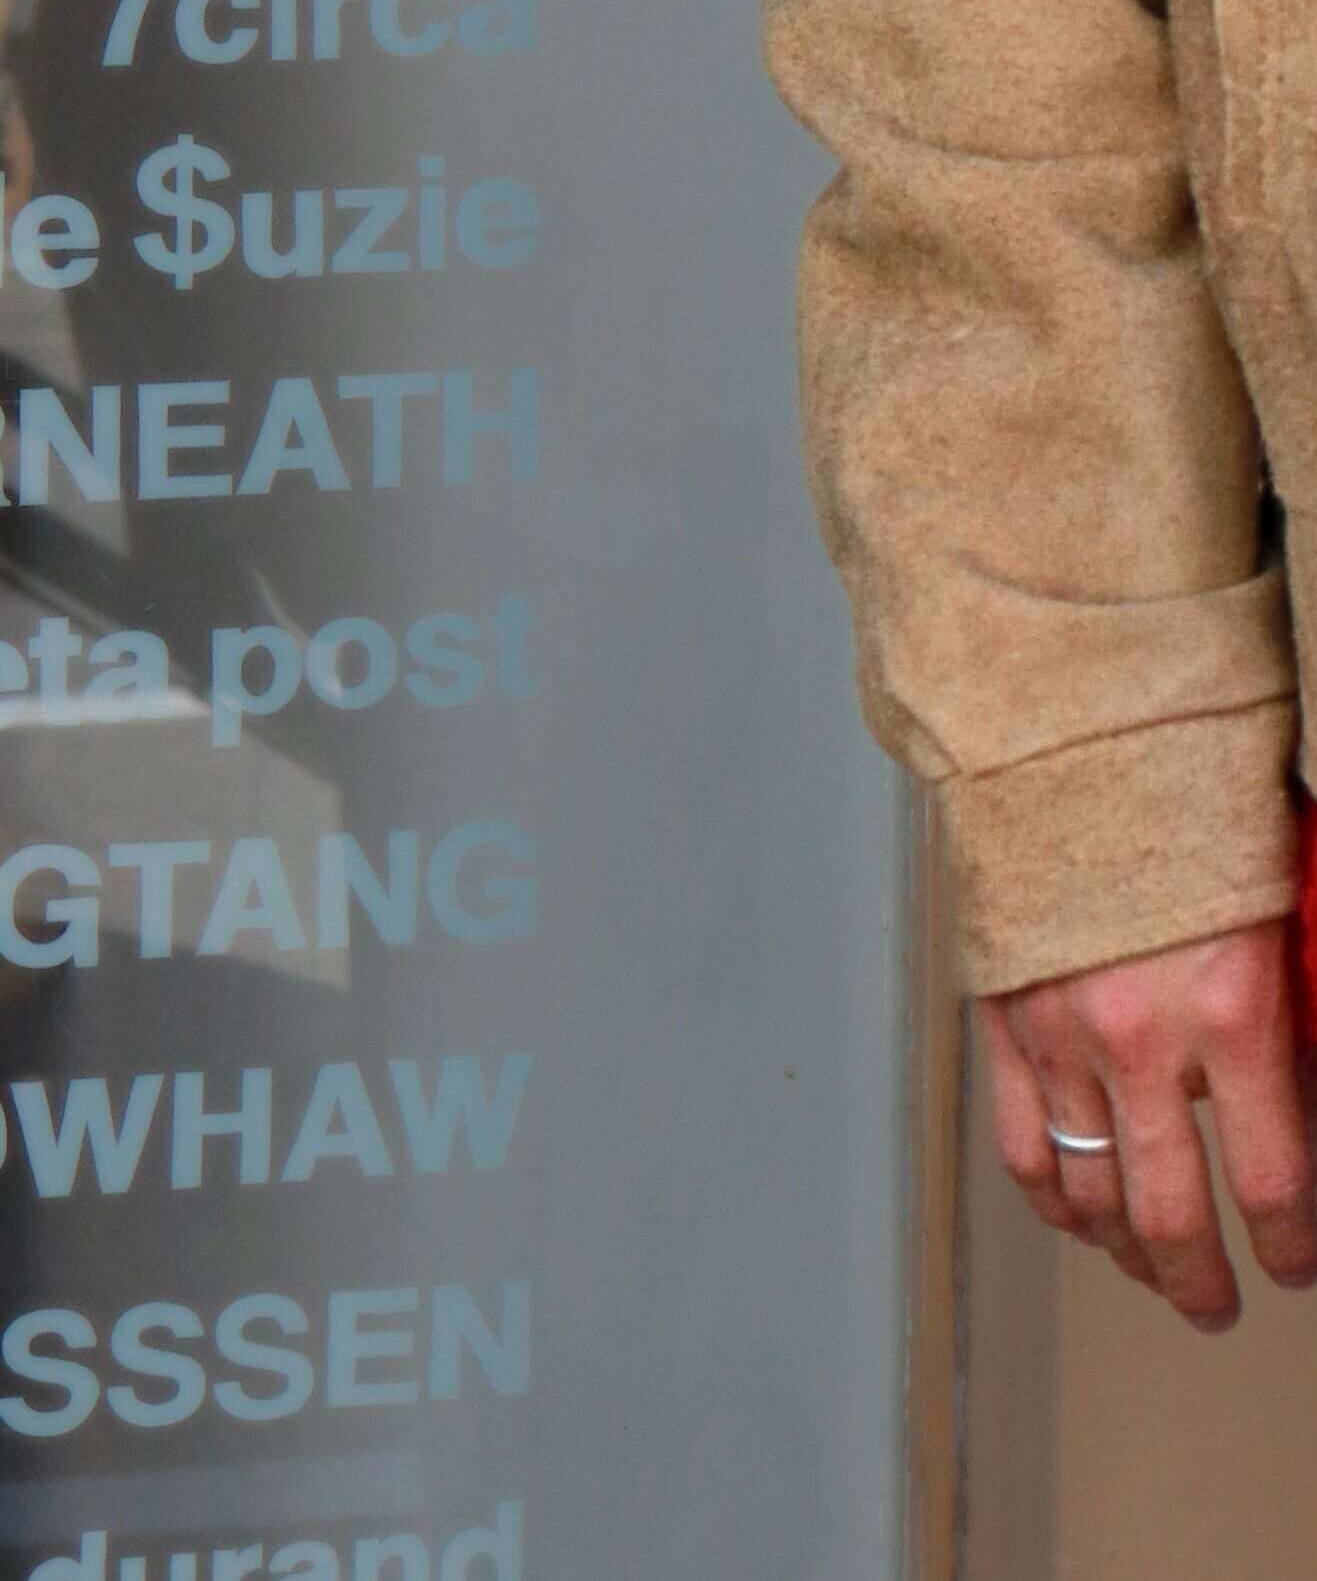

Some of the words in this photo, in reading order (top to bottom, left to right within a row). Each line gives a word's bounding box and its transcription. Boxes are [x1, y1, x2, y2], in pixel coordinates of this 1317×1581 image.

[134, 134, 540, 290] $uzie
[0, 367, 540, 507] NEATH
[210, 593, 540, 747] post
[0, 819, 538, 969] GTANG
[0, 1051, 533, 1198] WHAW
[0, 1281, 532, 1437] SSSEN
